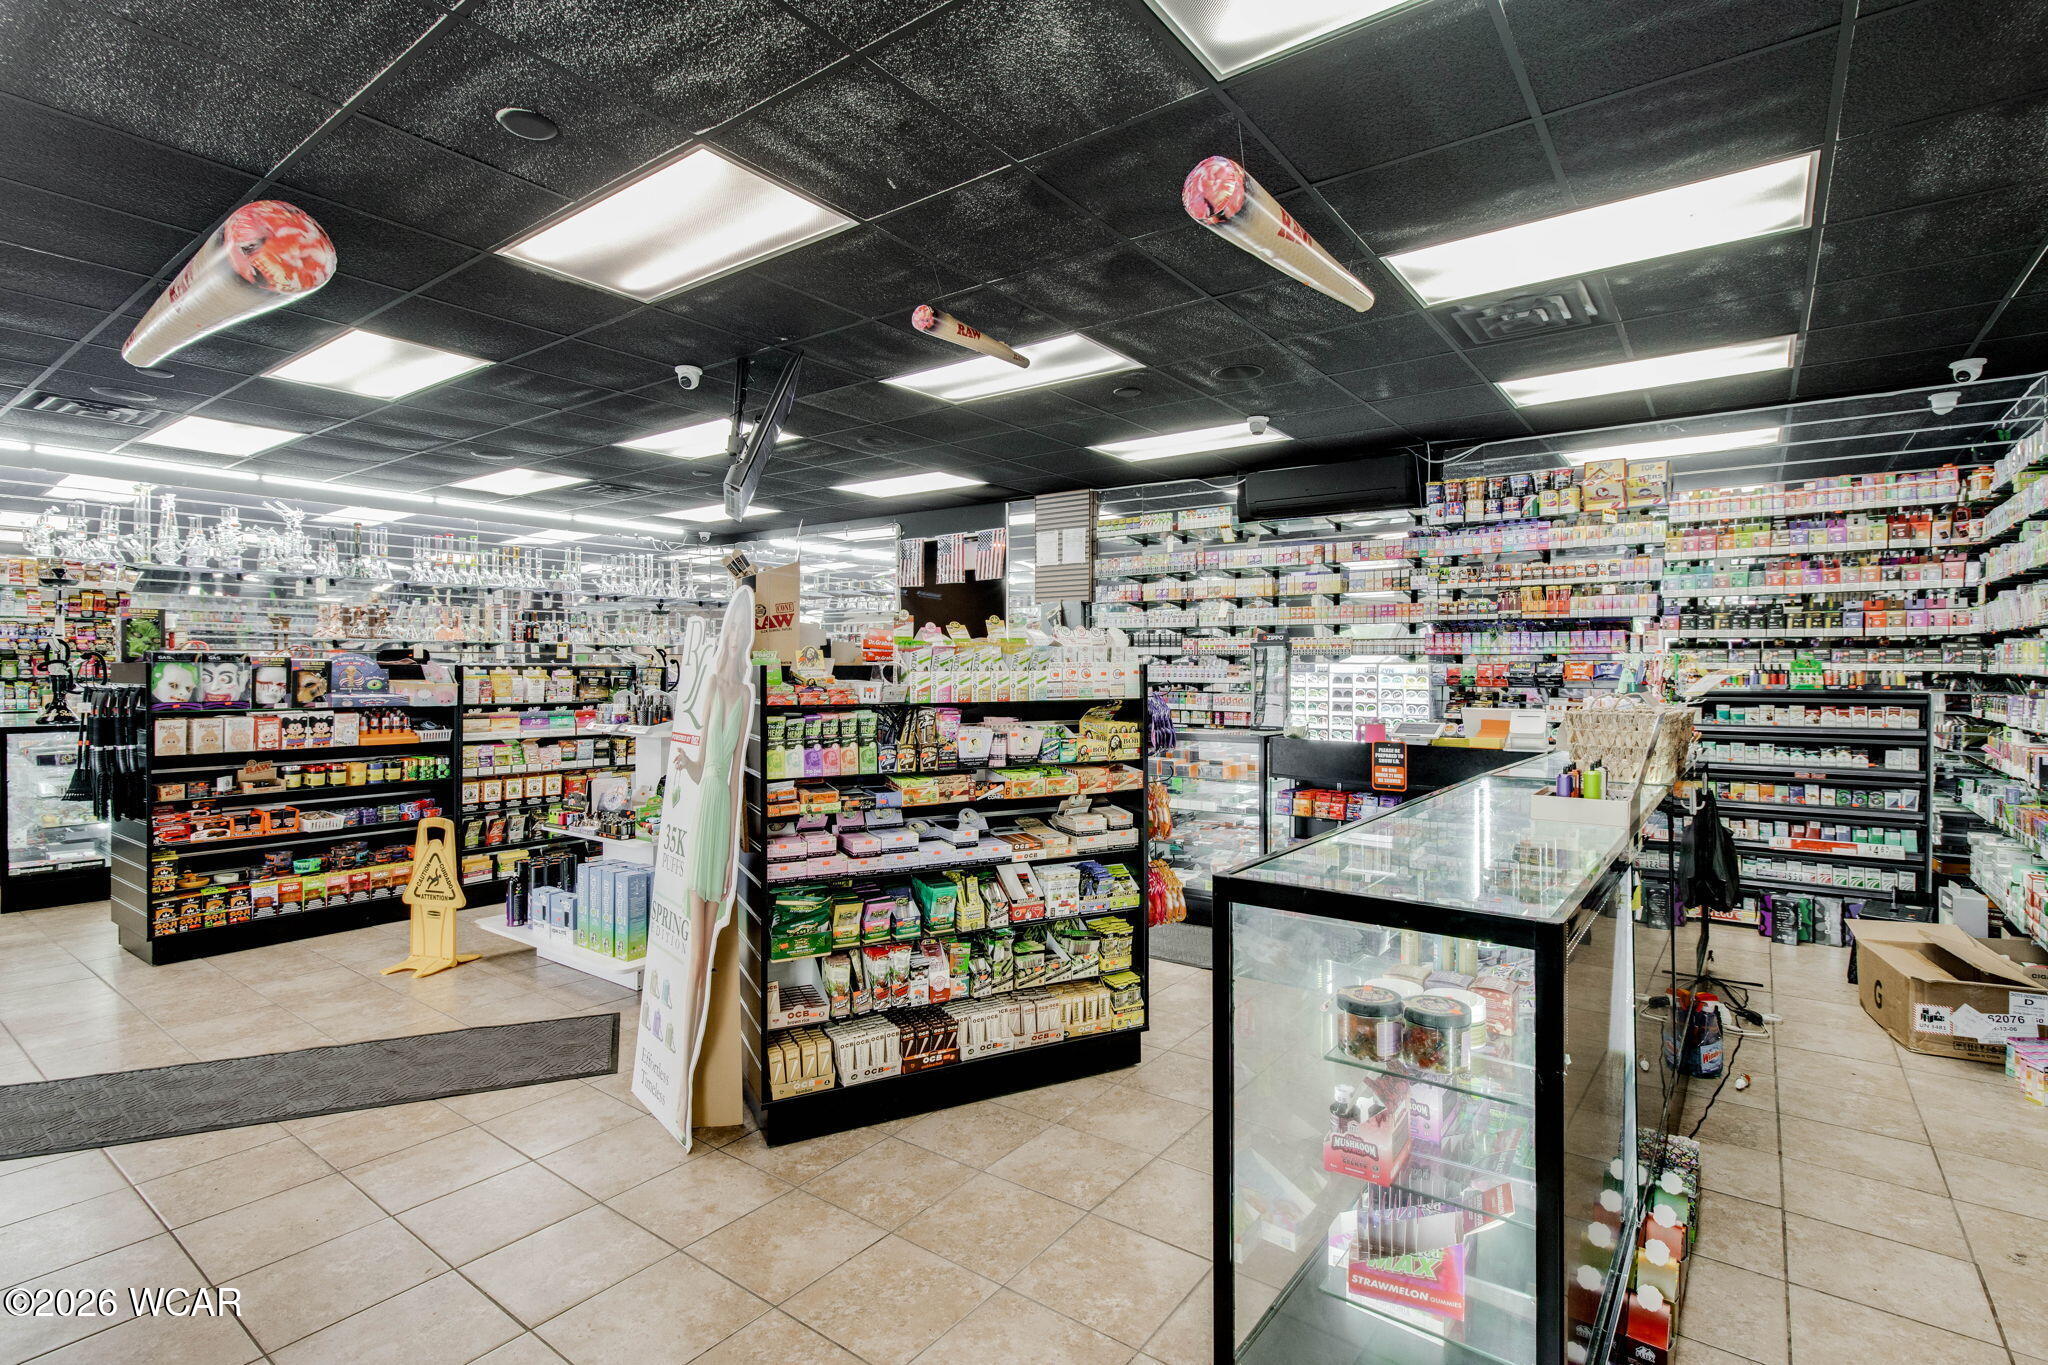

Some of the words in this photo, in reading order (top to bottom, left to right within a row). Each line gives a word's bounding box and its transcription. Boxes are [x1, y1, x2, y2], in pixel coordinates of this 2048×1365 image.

[956, 323, 981, 340] RAW
[755, 613, 794, 630] RAW
[861, 726, 876, 734] HEMP
[245, 764, 274, 775] RAW
[663, 824, 687, 858] 35K
[662, 853, 684, 877] PUFFS
[416, 862, 432, 887] CAUTION
[439, 863, 454, 889] CUIDADO
[420, 893, 449, 901] ATTENTION
[204, 913, 226, 922] GOJI
[230, 908, 251, 917] GOJI
[154, 920, 178, 930] GOJI
[180, 917, 201, 926] GOJI
[651, 900, 690, 941] SPRING
[650, 922, 687, 954] EDITION
[1874, 980, 1883, 1009] G
[787, 1010, 810, 1019] OCB
[1031, 1033, 1049, 1041] OCB
[840, 1042, 854, 1050] OCB
[980, 1043, 997, 1051] OCB
[923, 1054, 943, 1063] OCB
[864, 1067, 884, 1076] OCB
[793, 1079, 815, 1089] OCB
[1366, 1254, 1438, 1281] MAX
[1352, 1274, 1429, 1301] STRAWMELON
[1429, 1295, 1463, 1309] GUMMIES
